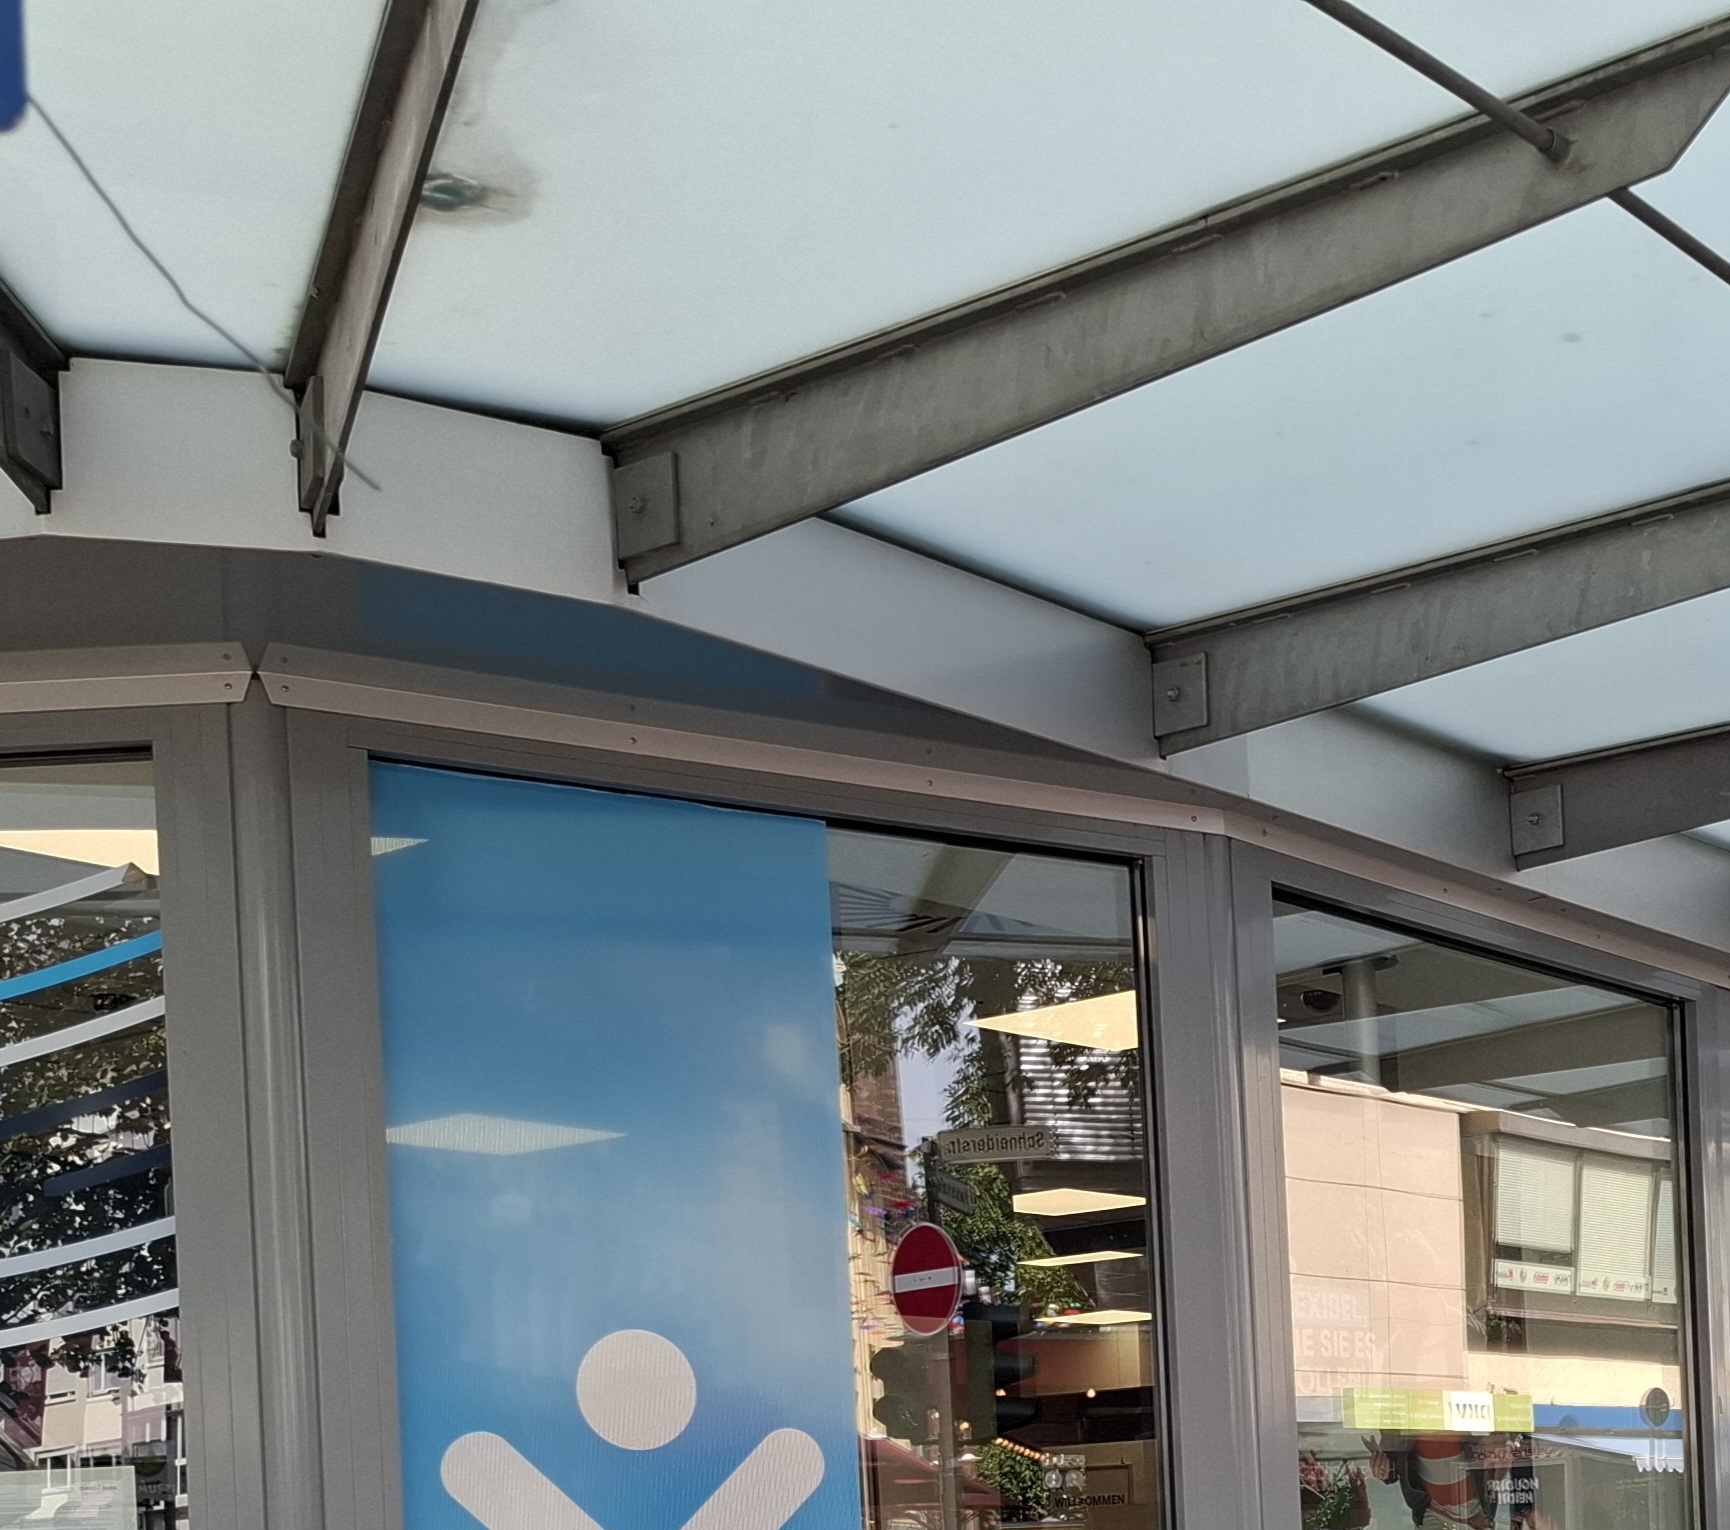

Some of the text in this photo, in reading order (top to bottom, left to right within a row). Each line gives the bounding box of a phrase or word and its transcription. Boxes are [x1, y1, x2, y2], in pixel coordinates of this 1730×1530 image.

[1320, 1329, 1350, 1358] SIE
[1354, 1331, 1376, 1360] ES
[1055, 1494, 1125, 1508] WILLKOMMEN
